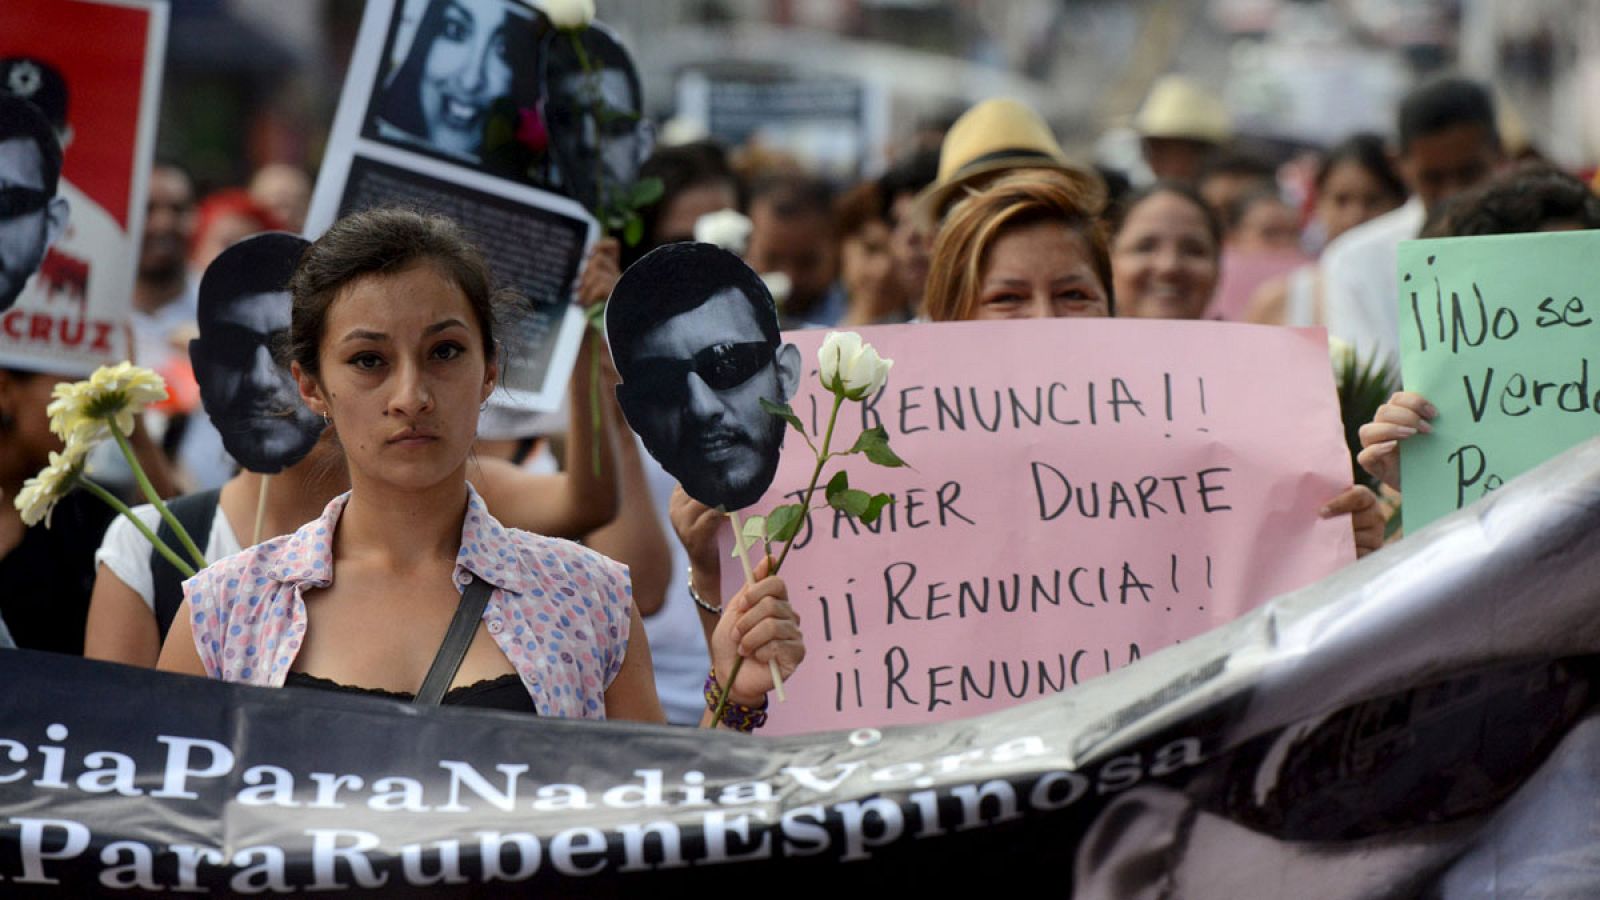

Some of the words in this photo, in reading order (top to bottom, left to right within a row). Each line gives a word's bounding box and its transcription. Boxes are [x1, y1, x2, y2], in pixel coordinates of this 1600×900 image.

[1536, 296, 1593, 328] se
[1031, 461, 1232, 520] DUARTE
[0, 735, 1202, 895] ParaRubenEspinosa
